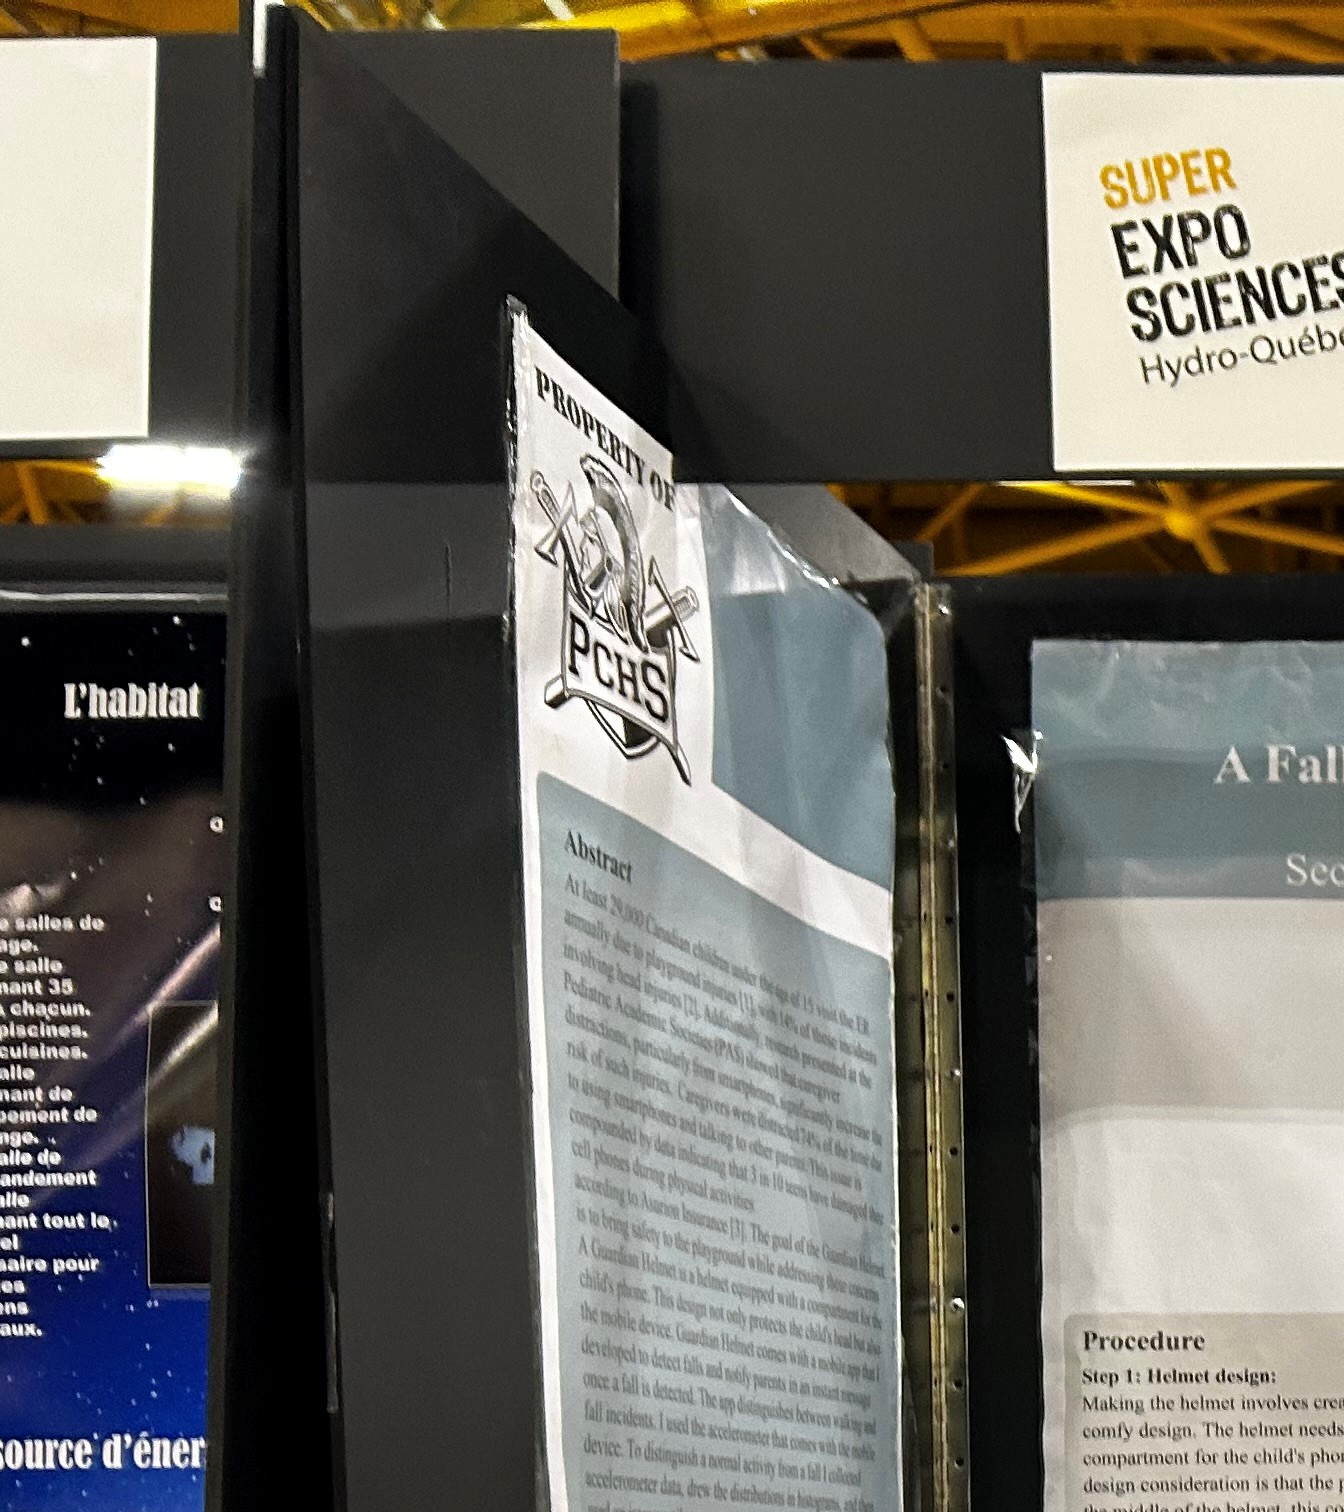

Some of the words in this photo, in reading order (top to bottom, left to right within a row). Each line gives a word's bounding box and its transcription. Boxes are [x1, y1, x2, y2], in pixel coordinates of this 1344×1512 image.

[1100, 147, 1237, 209] SUPER
[1110, 203, 1251, 279] EXPO
[535, 366, 646, 485] PROPERTY
[650, 470, 676, 511] OF
[567, 612, 669, 724] PCHS
[1215, 744, 1250, 783] A
[565, 829, 632, 884] Abstract
[53, 1257, 100, 1275] pour
[1083, 1330, 1206, 1353] Procedure
[1082, 1369, 1120, 1387] Step
[1126, 1368, 1141, 1384] 1:
[1148, 1368, 1210, 1384] Helmet
[1216, 1367, 1276, 1387] design:
[1082, 1396, 1145, 1415] Making
[1151, 1395, 1175, 1411] the
[1181, 1394, 1235, 1411] helmet
[1241, 1394, 1308, 1410] involves
